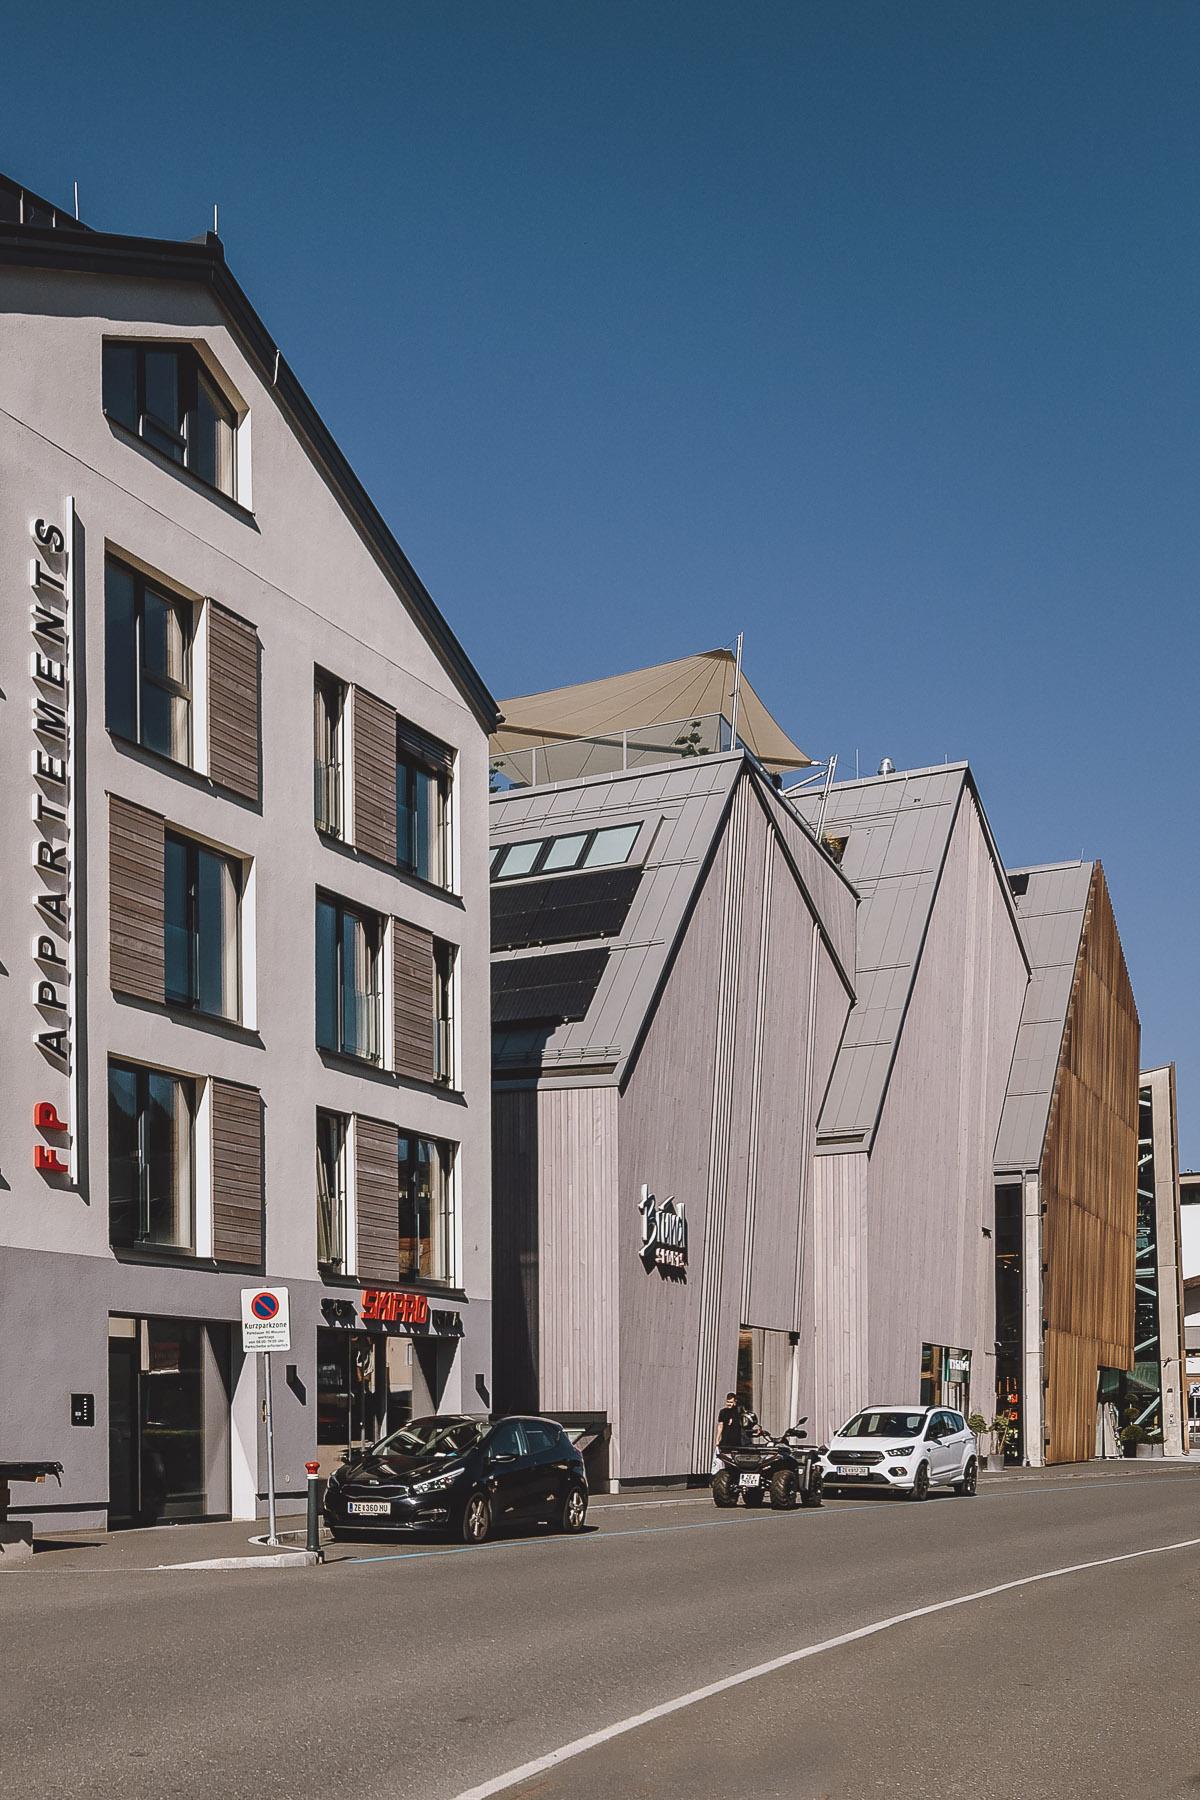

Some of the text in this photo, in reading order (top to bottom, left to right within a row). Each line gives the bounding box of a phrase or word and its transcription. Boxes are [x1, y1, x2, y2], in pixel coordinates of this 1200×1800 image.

[30, 516, 68, 1173] FP APPARTEMENTS
[361, 1288, 428, 1324] SKIPRO
[244, 1321, 288, 1331] Kurzparkzone
[354, 1503, 362, 1512] ZE
